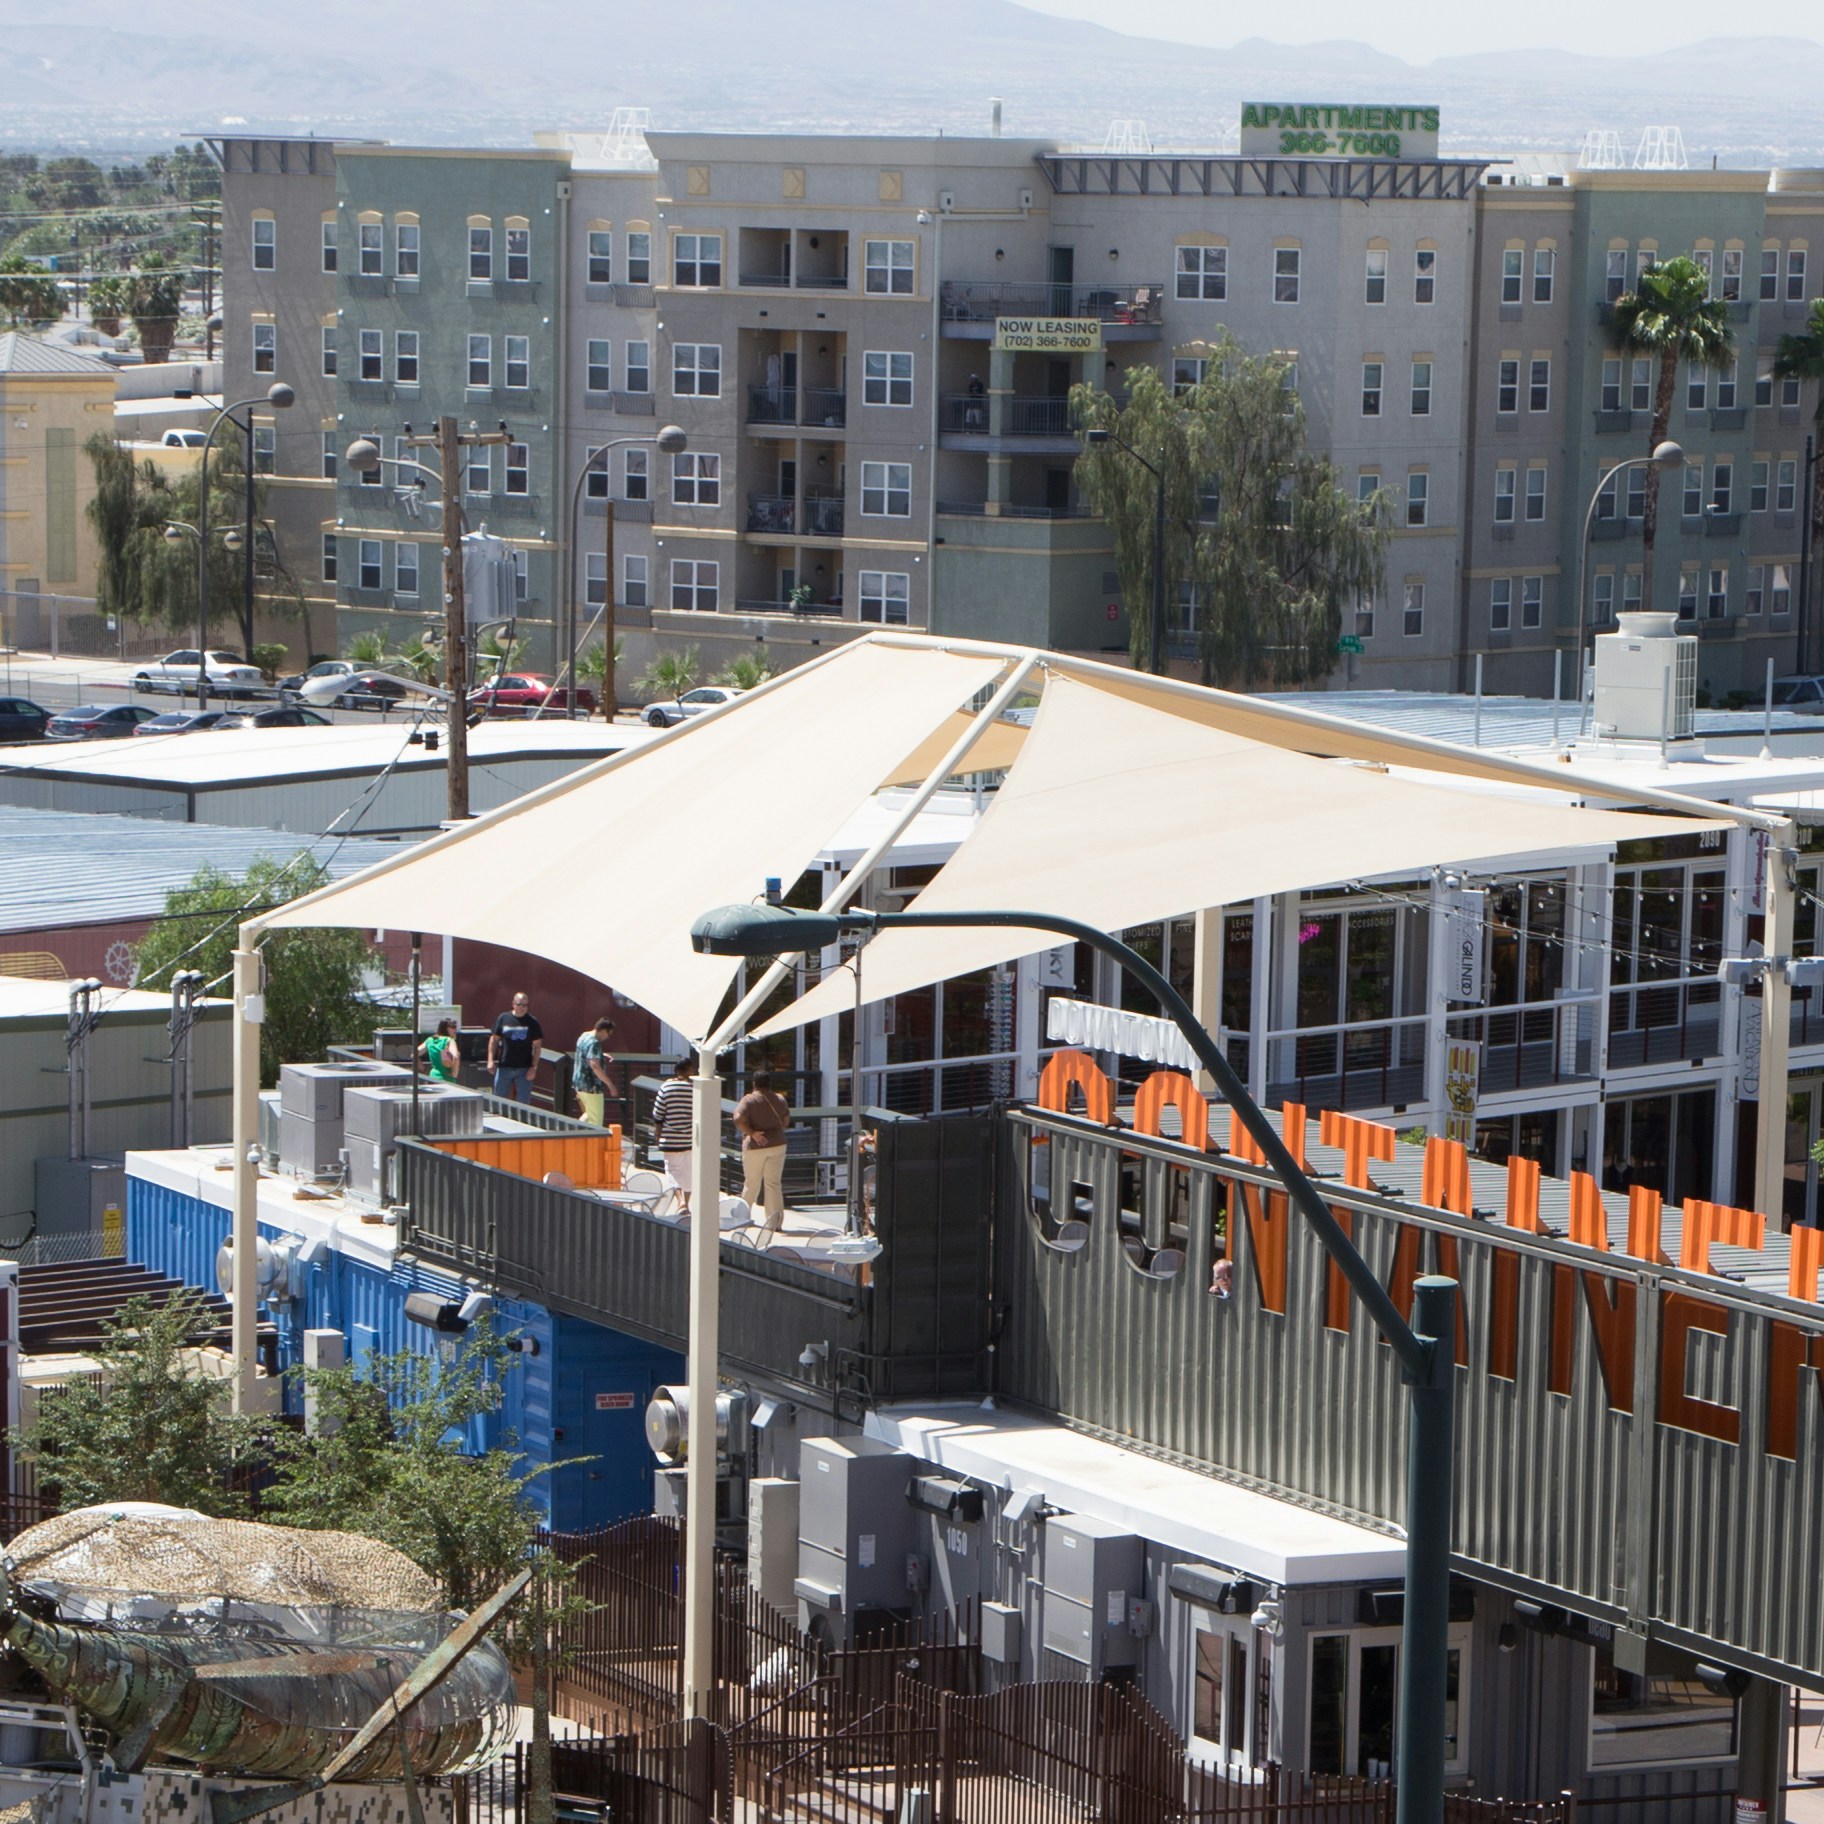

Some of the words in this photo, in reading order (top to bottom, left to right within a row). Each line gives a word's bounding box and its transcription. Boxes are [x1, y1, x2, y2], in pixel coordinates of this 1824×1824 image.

[1241, 104, 1440, 132] APARTMENTS
[1279, 131, 1401, 156] 366-7600
[998, 320, 1033, 333] NOW
[1036, 321, 1098, 334] LEASING
[1004, 335, 1033, 348] (702)
[1036, 336, 1091, 348] 366-7600
[947, 1526, 968, 1556] 1050
